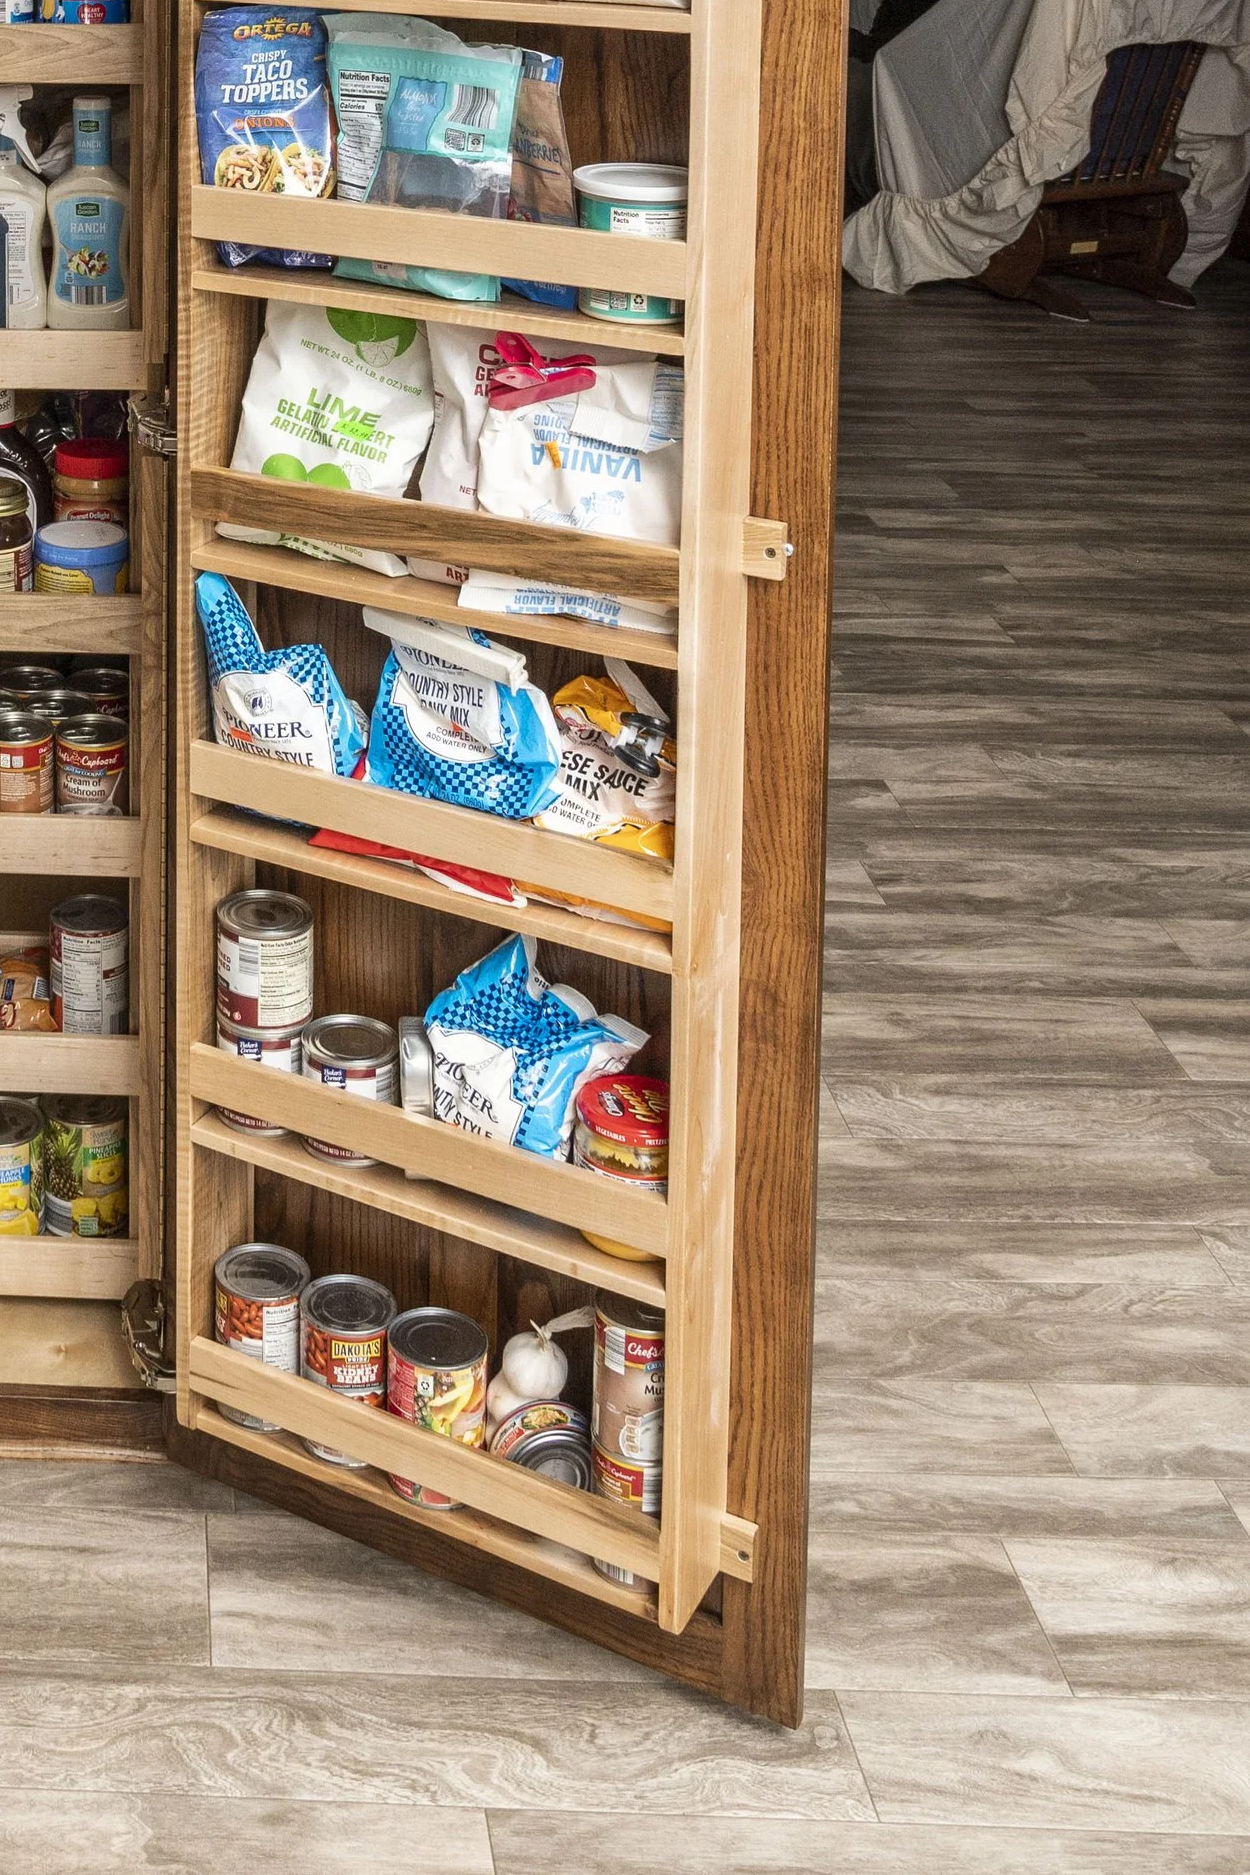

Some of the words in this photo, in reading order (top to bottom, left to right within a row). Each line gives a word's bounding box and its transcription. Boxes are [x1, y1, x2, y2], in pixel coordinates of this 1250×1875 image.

[232, 22, 312, 41] ORTEGA
[252, 49, 287, 63] CRISPY
[242, 59, 293, 85] TACO
[340, 71, 370, 81] Nutrition
[370, 73, 390, 83] Facts
[221, 77, 308, 104] TOPPERS
[340, 101, 365, 111] Calories
[234, 117, 294, 130] ONIONS
[613, 210, 640, 218] Nutrition
[613, 217, 630, 225] Facts
[70, 222, 106, 234] RANCH
[300, 339, 318, 353] NET
[330, 350, 341, 361] 24
[341, 355, 354, 368] OZ.
[365, 367, 378, 380] LB.
[379, 375, 386, 383] 8
[403, 385, 422, 397] 680g
[277, 398, 330, 429] GELATIN
[306, 387, 382, 429] LIME
[270, 415, 333, 448] ARTIFICIAL
[336, 438, 388, 465] FLAVOR
[514, 594, 556, 605] FLAVOR
[560, 595, 621, 617] ARTIFICIAL
[404, 671, 450, 701] OUNTRY
[452, 681, 484, 708] STYLE
[222, 707, 313, 739] PIONEER
[450, 707, 470, 728] MIX
[221, 728, 272, 759] COUNTRY
[275, 749, 314, 768] STYLE
[426, 731, 442, 743] ADD
[442, 739, 468, 749] WATER
[468, 744, 488, 754] ONLY
[81, 753, 119, 769] Cupboard
[65, 774, 91, 787] Cream
[92, 775, 102, 787] of
[565, 773, 602, 802] MIX
[594, 764, 650, 797] SAUCE
[62, 783, 106, 797] Mushroom
[560, 809, 586, 825] WATER
[238, 1041, 258, 1049] Baker's
[323, 1068, 343, 1076] Baker's
[434, 1052, 500, 1123] PIOEER
[595, 1125, 626, 1143] VEGETABLES
[89, 1141, 121, 1154] PINEAPPLE
[265, 1307, 292, 1315] Nutrition
[333, 1341, 380, 1357] DAKOTA'S
[627, 1342, 658, 1357] Chef's
[333, 1365, 379, 1376] KIDNEY
[336, 1373, 376, 1384] BEANS
